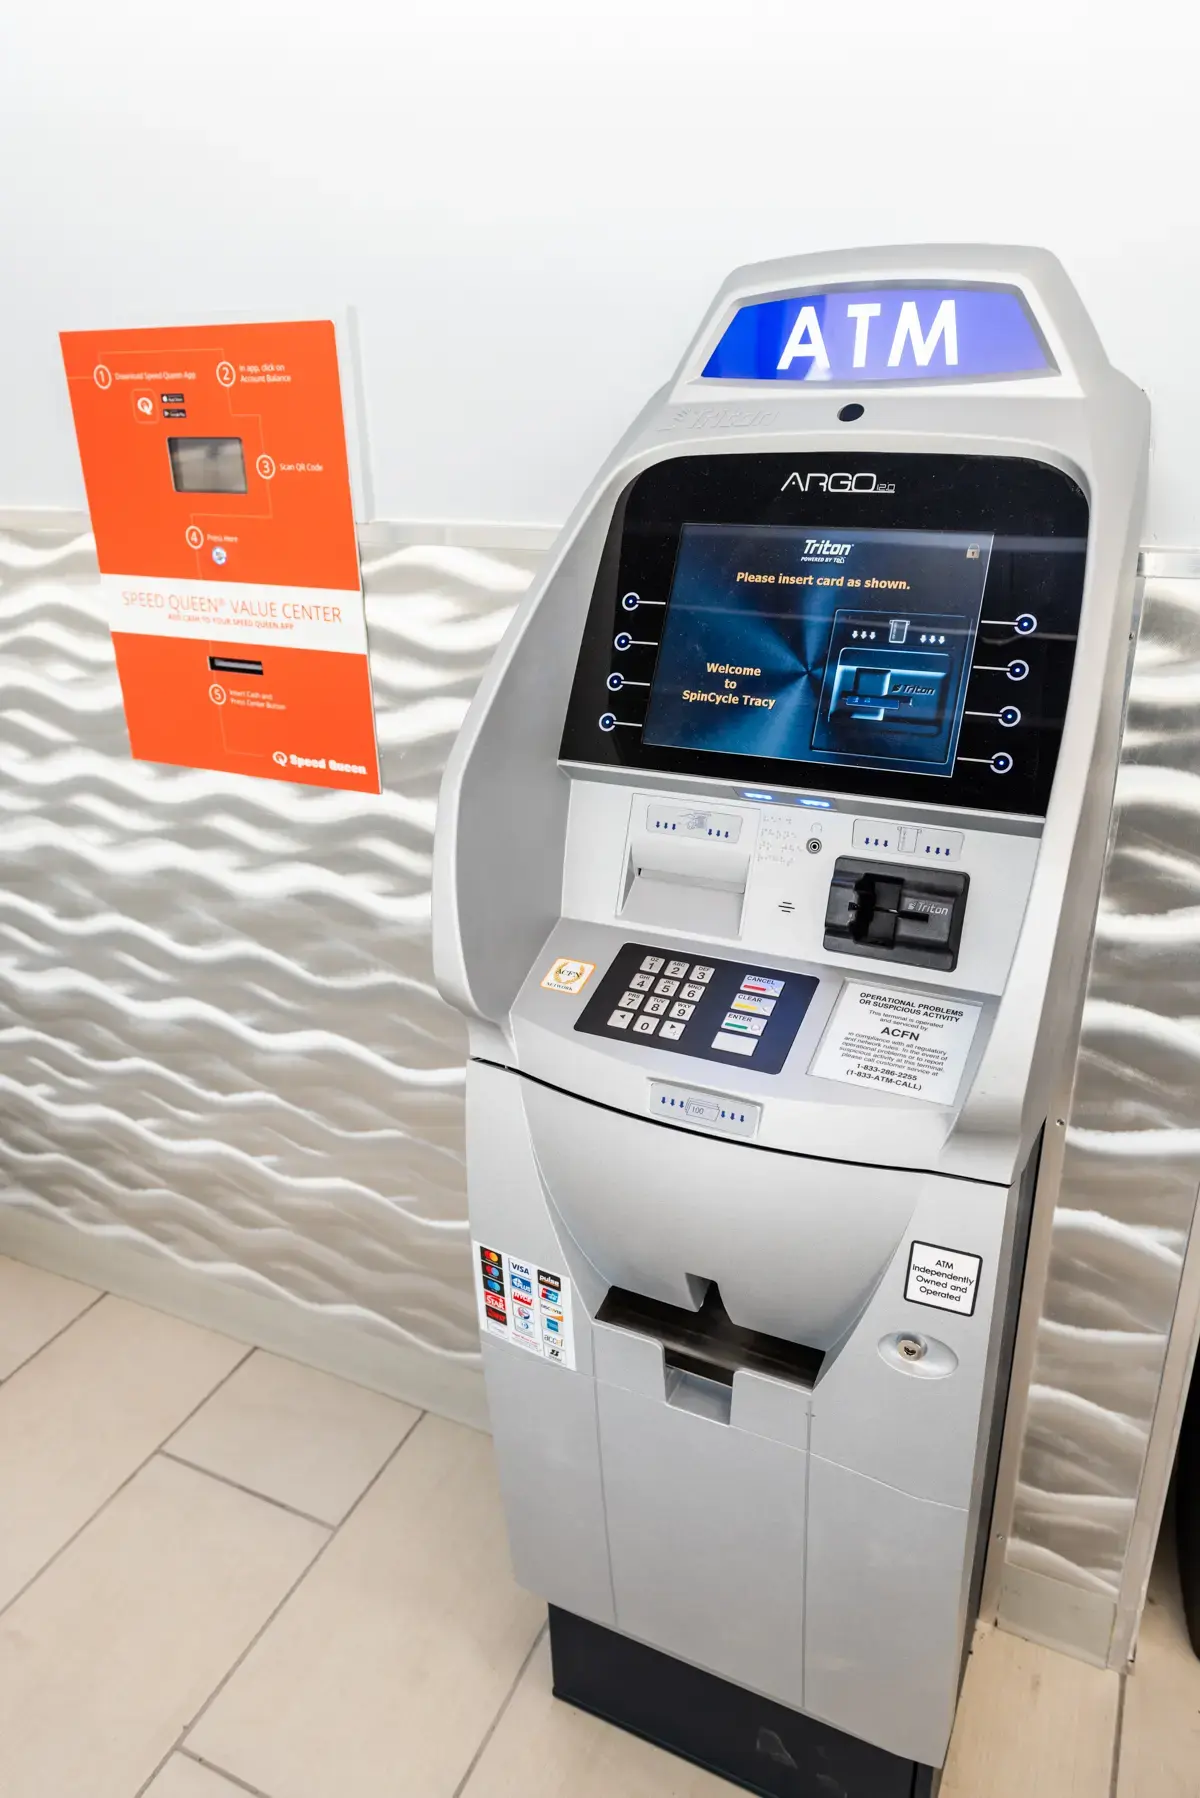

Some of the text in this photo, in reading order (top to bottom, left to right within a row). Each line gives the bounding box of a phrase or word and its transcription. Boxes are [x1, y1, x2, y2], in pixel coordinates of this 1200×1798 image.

[776, 299, 959, 370] ATM
[222, 366, 231, 381] 2
[262, 459, 270, 474] 3
[279, 462, 295, 471] Scan
[780, 472, 877, 492] ARGO
[190, 531, 198, 543] 4
[803, 539, 851, 555] Triton
[736, 572, 911, 590] Please insert card as shown.
[122, 591, 165, 608] SPEED
[230, 600, 277, 618] VALUE
[282, 603, 343, 624] CENTER
[233, 618, 254, 627] SPEED
[255, 620, 279, 629] QUEEN
[706, 662, 762, 676] Welcome
[724, 678, 737, 689] to
[682, 690, 776, 710] SpinCycle Tracy
[289, 754, 326, 768] Speed
[328, 760, 367, 774] Queen
[917, 902, 949, 915] Triton
[648, 962, 655, 970] 1
[671, 967, 680, 975] 2
[697, 972, 706, 980] 3
[746, 975, 775, 985] CANCEL
[637, 980, 645, 988] 4
[661, 985, 671, 993] 5
[687, 989, 696, 998] 6
[737, 994, 762, 1003] CLEAR
[626, 998, 635, 1006] 7
[651, 1003, 660, 1012] 8
[860, 992, 964, 1017] OPERATIONAL PROBLEMS
[676, 1008, 686, 1017] 9
[728, 1013, 753, 1022] ENTER
[869, 1009, 882, 1017] This
[883, 1012, 908, 1021] terminal
[915, 1019, 944, 1029] operated
[872, 1001, 921, 1015] SUSPICIOUS
[922, 1010, 961, 1023] ACTIVITY
[640, 1022, 650, 1031] 0
[893, 1019, 919, 1029] serviced
[920, 1024, 929, 1032] by
[881, 1026, 920, 1040] ACFN
[855, 1033, 891, 1044] compliance
[914, 1045, 947, 1056] regulatory
[857, 1038, 881, 1047] network
[921, 1052, 940, 1060] event
[841, 1041, 877, 1052] operational
[877, 1048, 907, 1059] problems
[924, 1058, 944, 1067] report
[841, 1052, 863, 1061] please
[875, 1059, 905, 1069] customer
[906, 1066, 930, 1075] service
[856, 1063, 917, 1081] 1-833-286-2255
[846, 1069, 922, 1091] (1-833-ATM-CALL)
[691, 1106, 704, 1115] 100
[511, 1262, 529, 1275] VISA
[935, 1259, 954, 1270] ATM
[912, 1263, 975, 1286] Independently
[916, 1275, 968, 1294] Owned and
[919, 1285, 961, 1302] Operated
[486, 1296, 505, 1310] STAR
